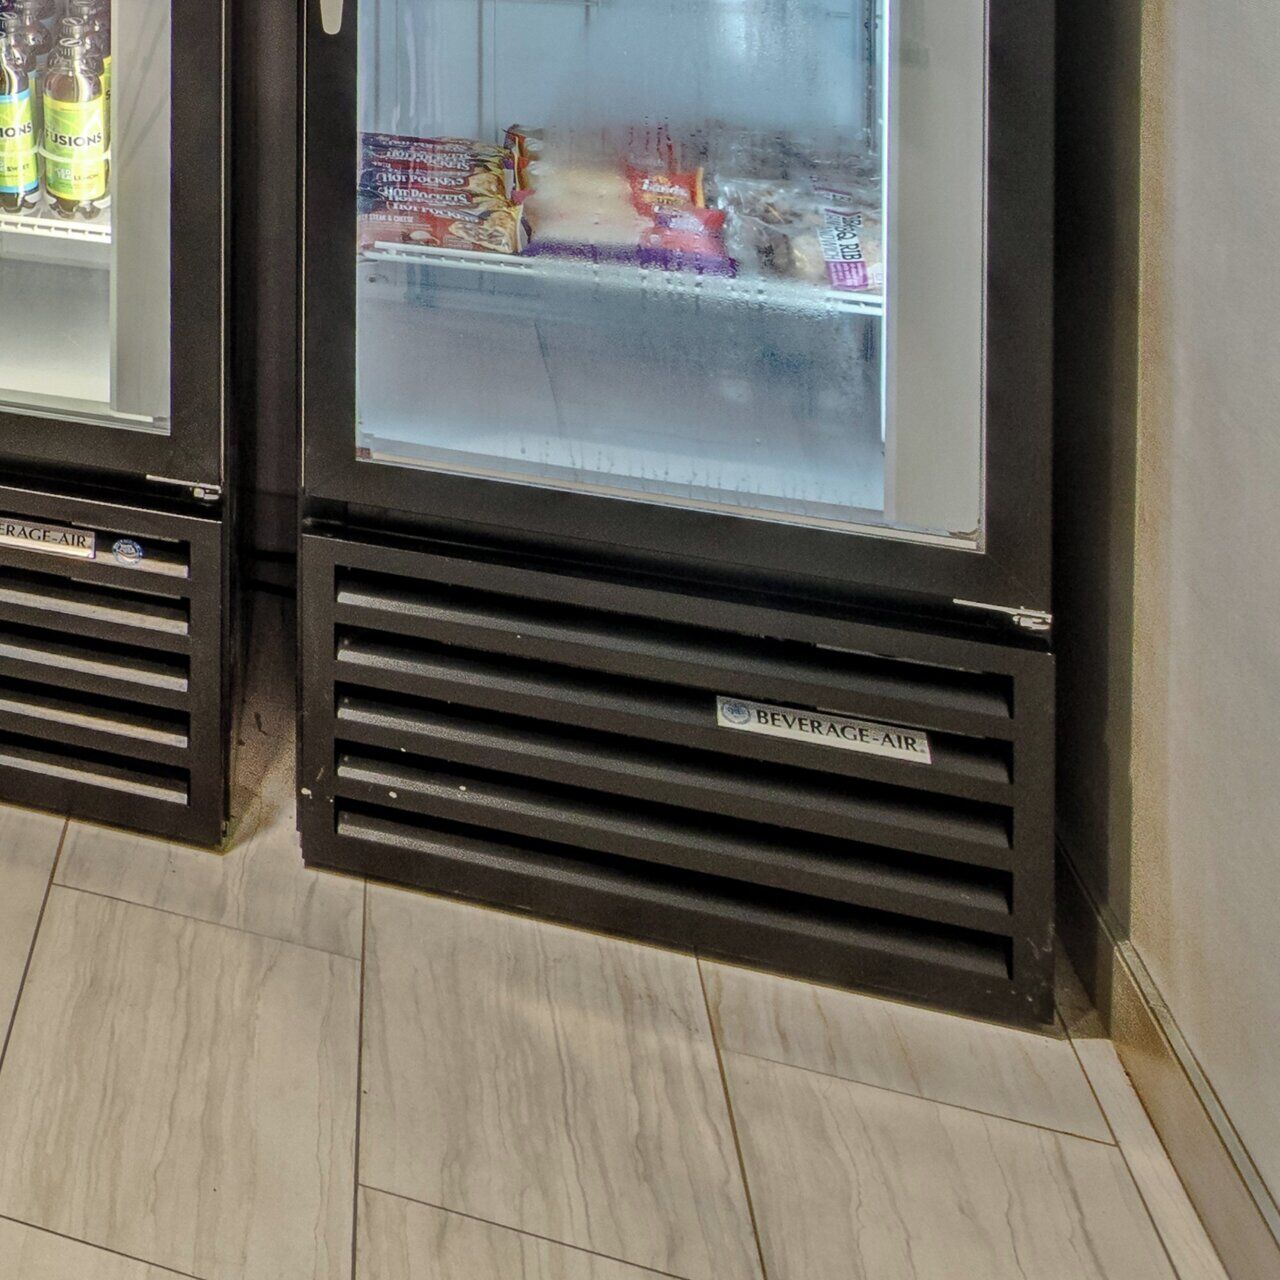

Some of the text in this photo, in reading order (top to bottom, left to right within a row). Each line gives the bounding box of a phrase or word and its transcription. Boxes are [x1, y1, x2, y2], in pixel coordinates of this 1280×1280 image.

[45, 128, 102, 147] FUSIONS
[381, 172, 465, 186] HOT POCKETS
[840, 243, 862, 261] RIB
[756, 709, 918, 753] BEVERAGE-AIR
